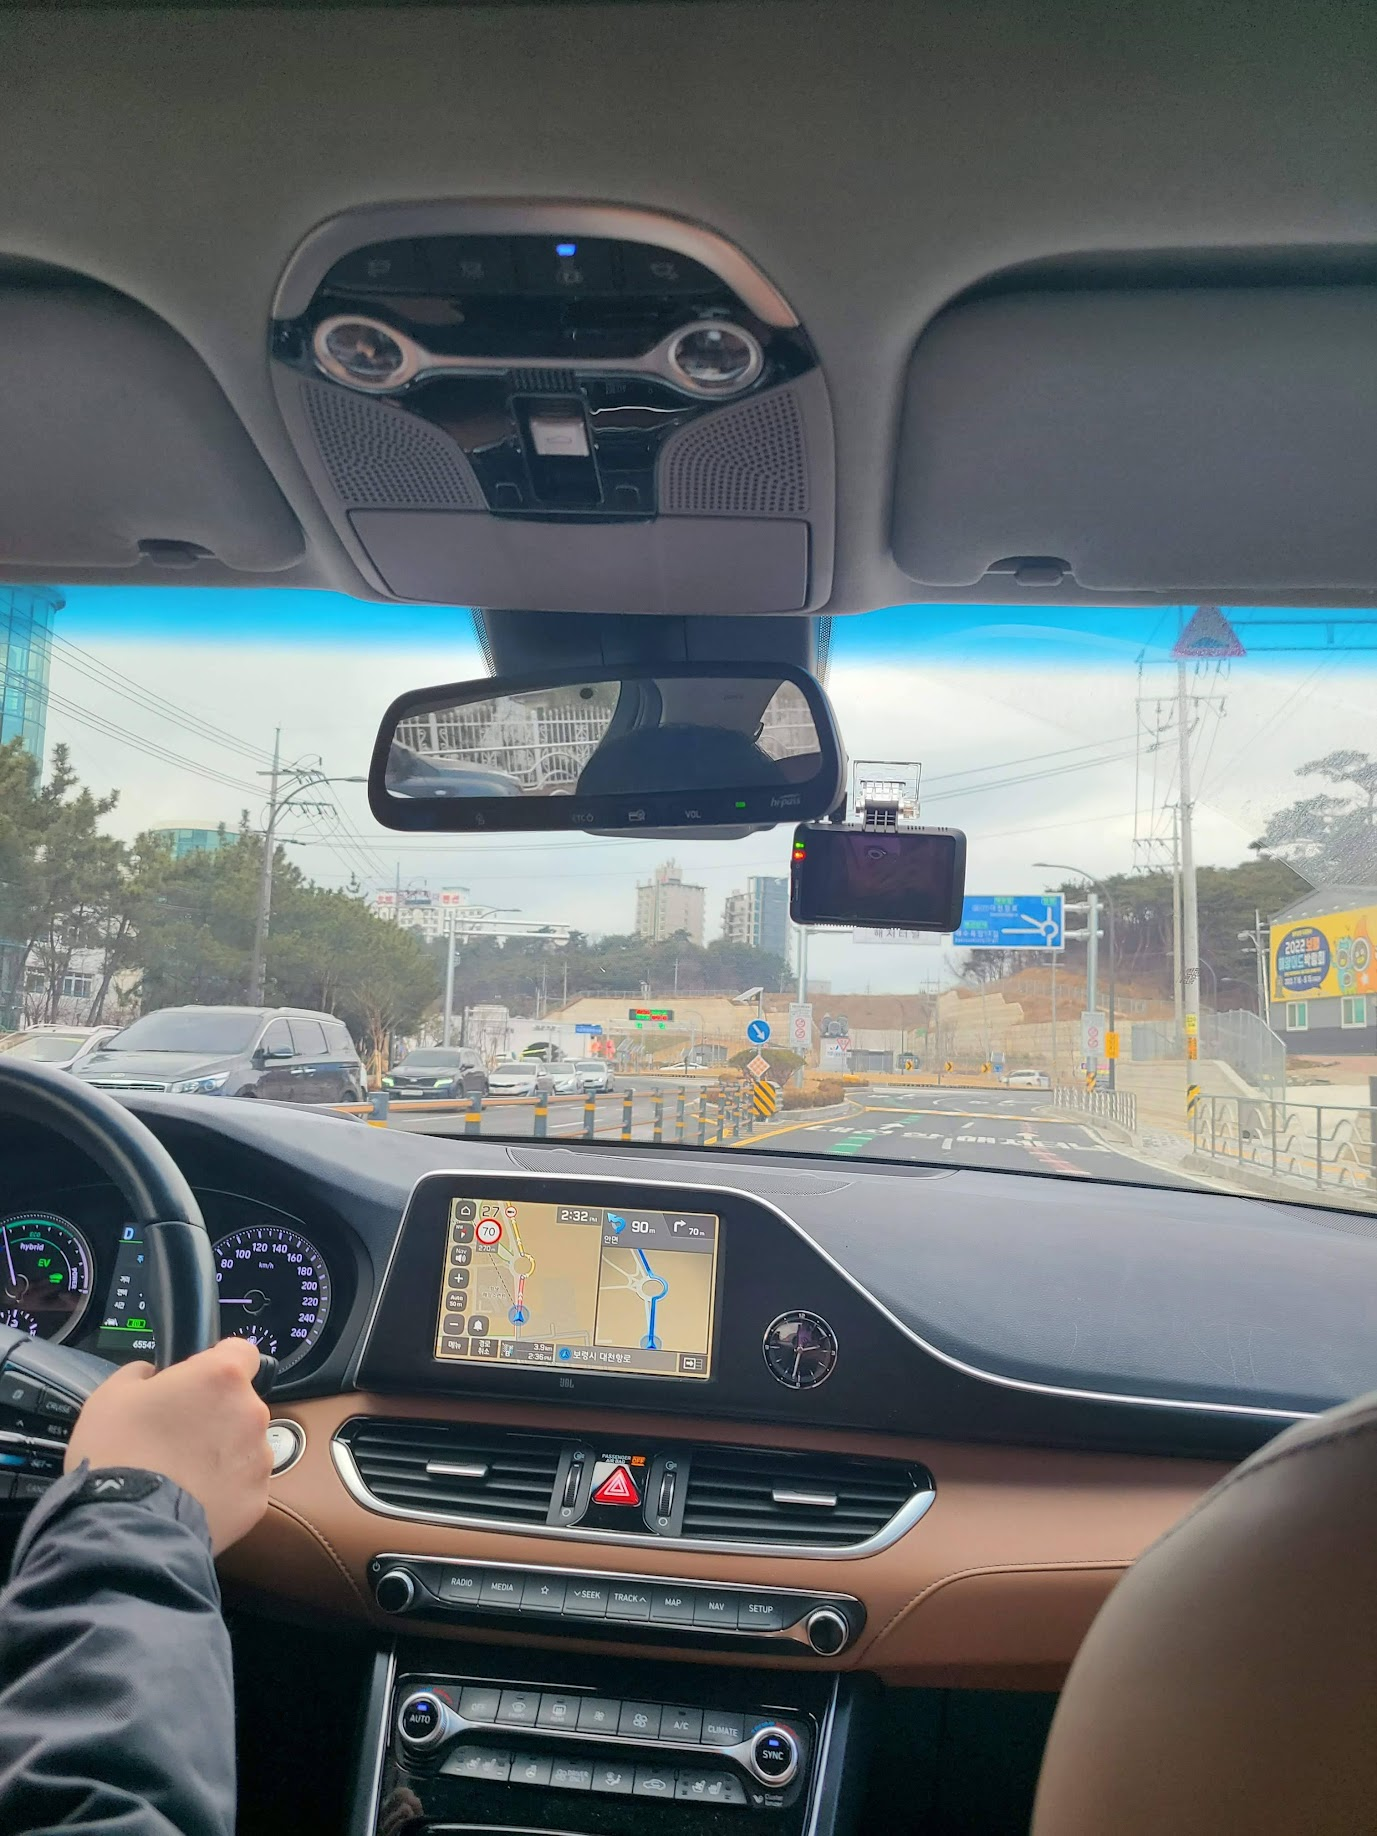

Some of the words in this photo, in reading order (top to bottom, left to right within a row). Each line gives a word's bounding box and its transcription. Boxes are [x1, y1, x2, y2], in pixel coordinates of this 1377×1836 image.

[685, 810, 701, 819] VOL
[1285, 939, 1306, 955] 2022
[482, 1206, 500, 1218] 27
[561, 1210, 589, 1222] 2:32
[123, 1227, 134, 1240] D
[482, 1227, 496, 1237] 70
[20, 1242, 45, 1252] hybrid
[252, 1243, 268, 1252] 120
[272, 1244, 288, 1254] 140
[235, 1249, 251, 1259] 100
[287, 1253, 303, 1263] 160
[37, 1258, 51, 1267] EV
[220, 1259, 234, 1269] 80
[297, 1266, 313, 1276] 180
[301, 1281, 318, 1291] 200
[302, 1297, 318, 1307] 220
[298, 1313, 315, 1323] 240
[290, 1328, 307, 1338] 260
[271, 1346, 277, 1354] F
[573, 1350, 597, 1361] 보령시
[599, 1352, 632, 1364] 대천항로
[601, 1453, 631, 1461] PASSENGER
[451, 1577, 473, 1587] RADIO
[491, 1583, 514, 1592] MEDIA
[581, 1590, 601, 1599] SEEK
[614, 1593, 638, 1603] TRACK
[664, 1598, 682, 1607] MAP
[708, 1602, 725, 1611] NAV
[748, 1604, 774, 1614] SETUP
[409, 1714, 431, 1725] AUTO
[673, 1721, 690, 1730] A/C
[707, 1725, 738, 1737] CLIMATE
[762, 1750, 784, 1761] SYNC
